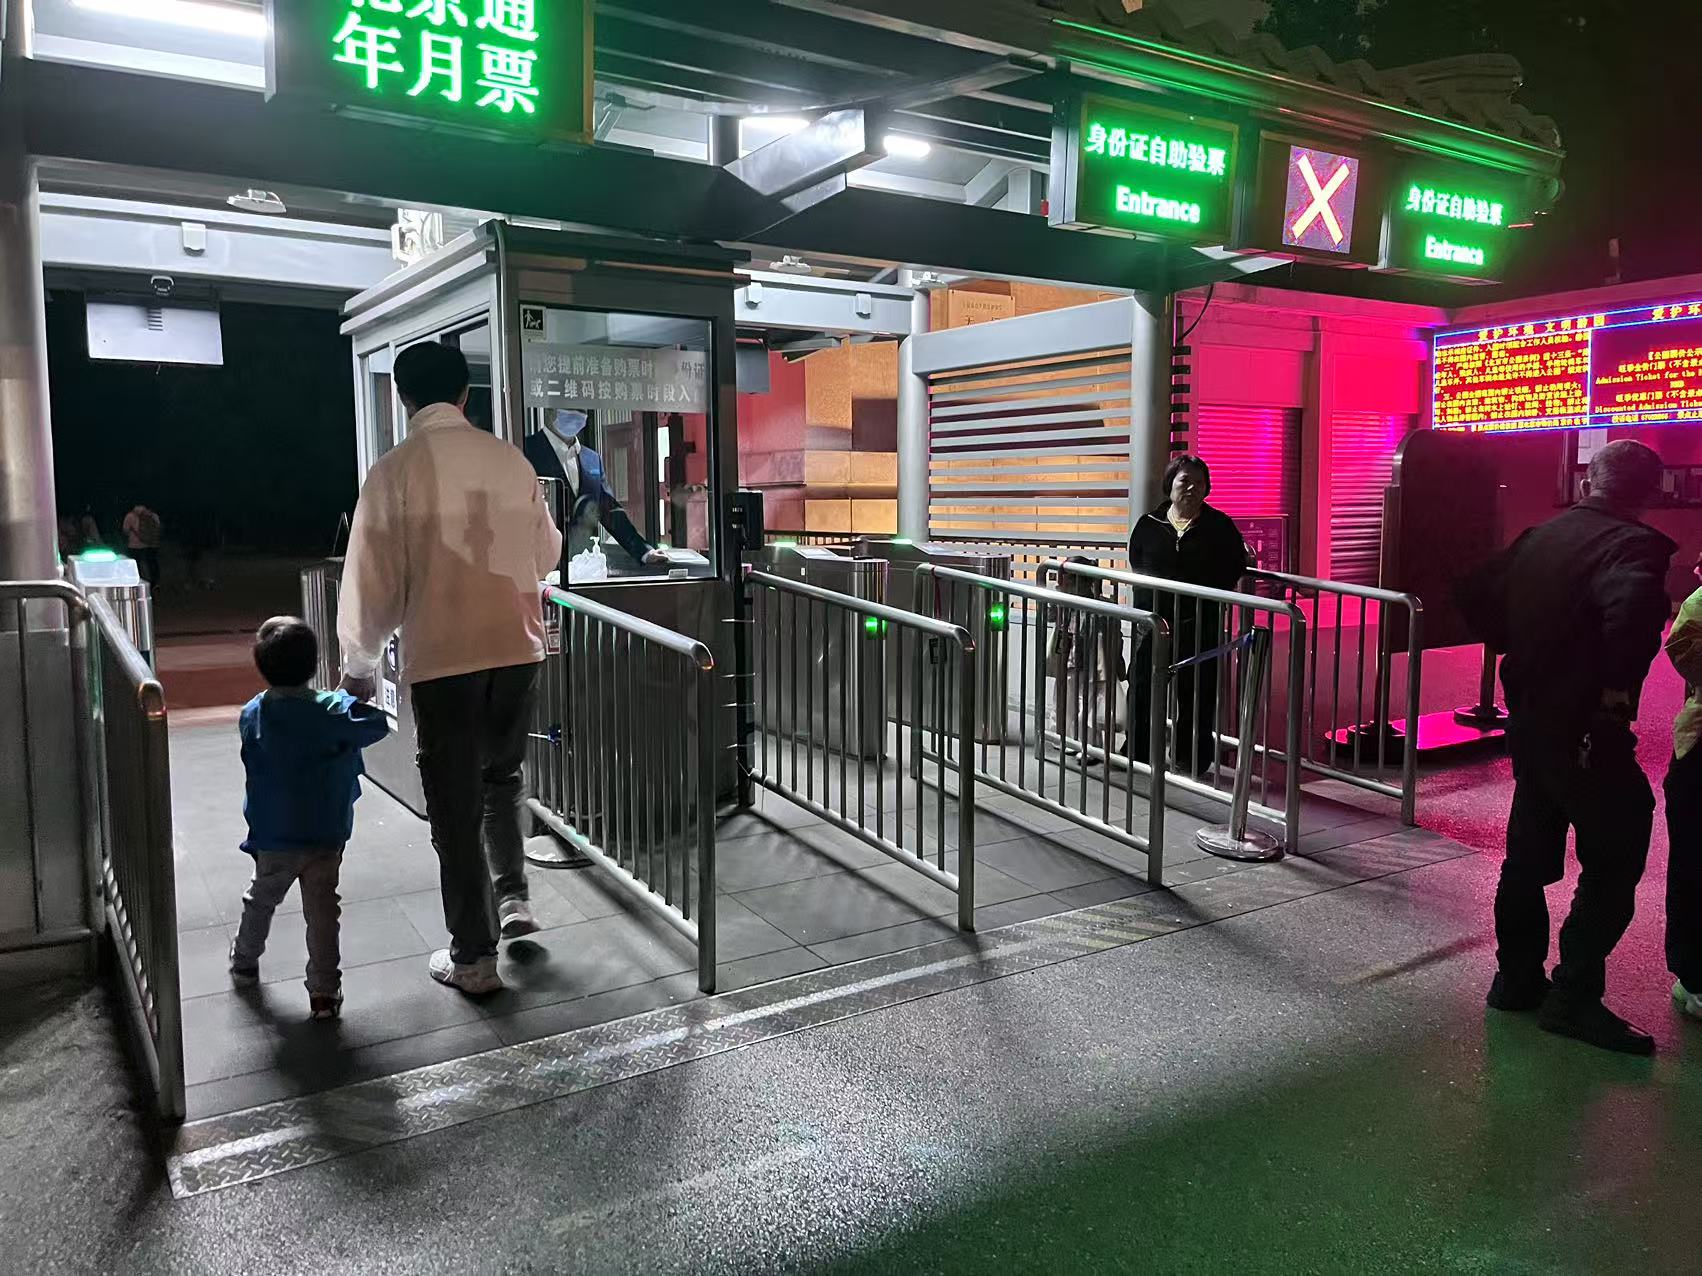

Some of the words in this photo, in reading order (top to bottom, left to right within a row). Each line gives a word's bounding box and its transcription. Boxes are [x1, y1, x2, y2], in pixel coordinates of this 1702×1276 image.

[332, 11, 539, 113] 年月票
[1085, 122, 1226, 175] 身份证自助验票
[1115, 184, 1201, 224] Entrance
[1405, 184, 1503, 225] 身份证自助验票
[1425, 234, 1484, 265] Entrance
